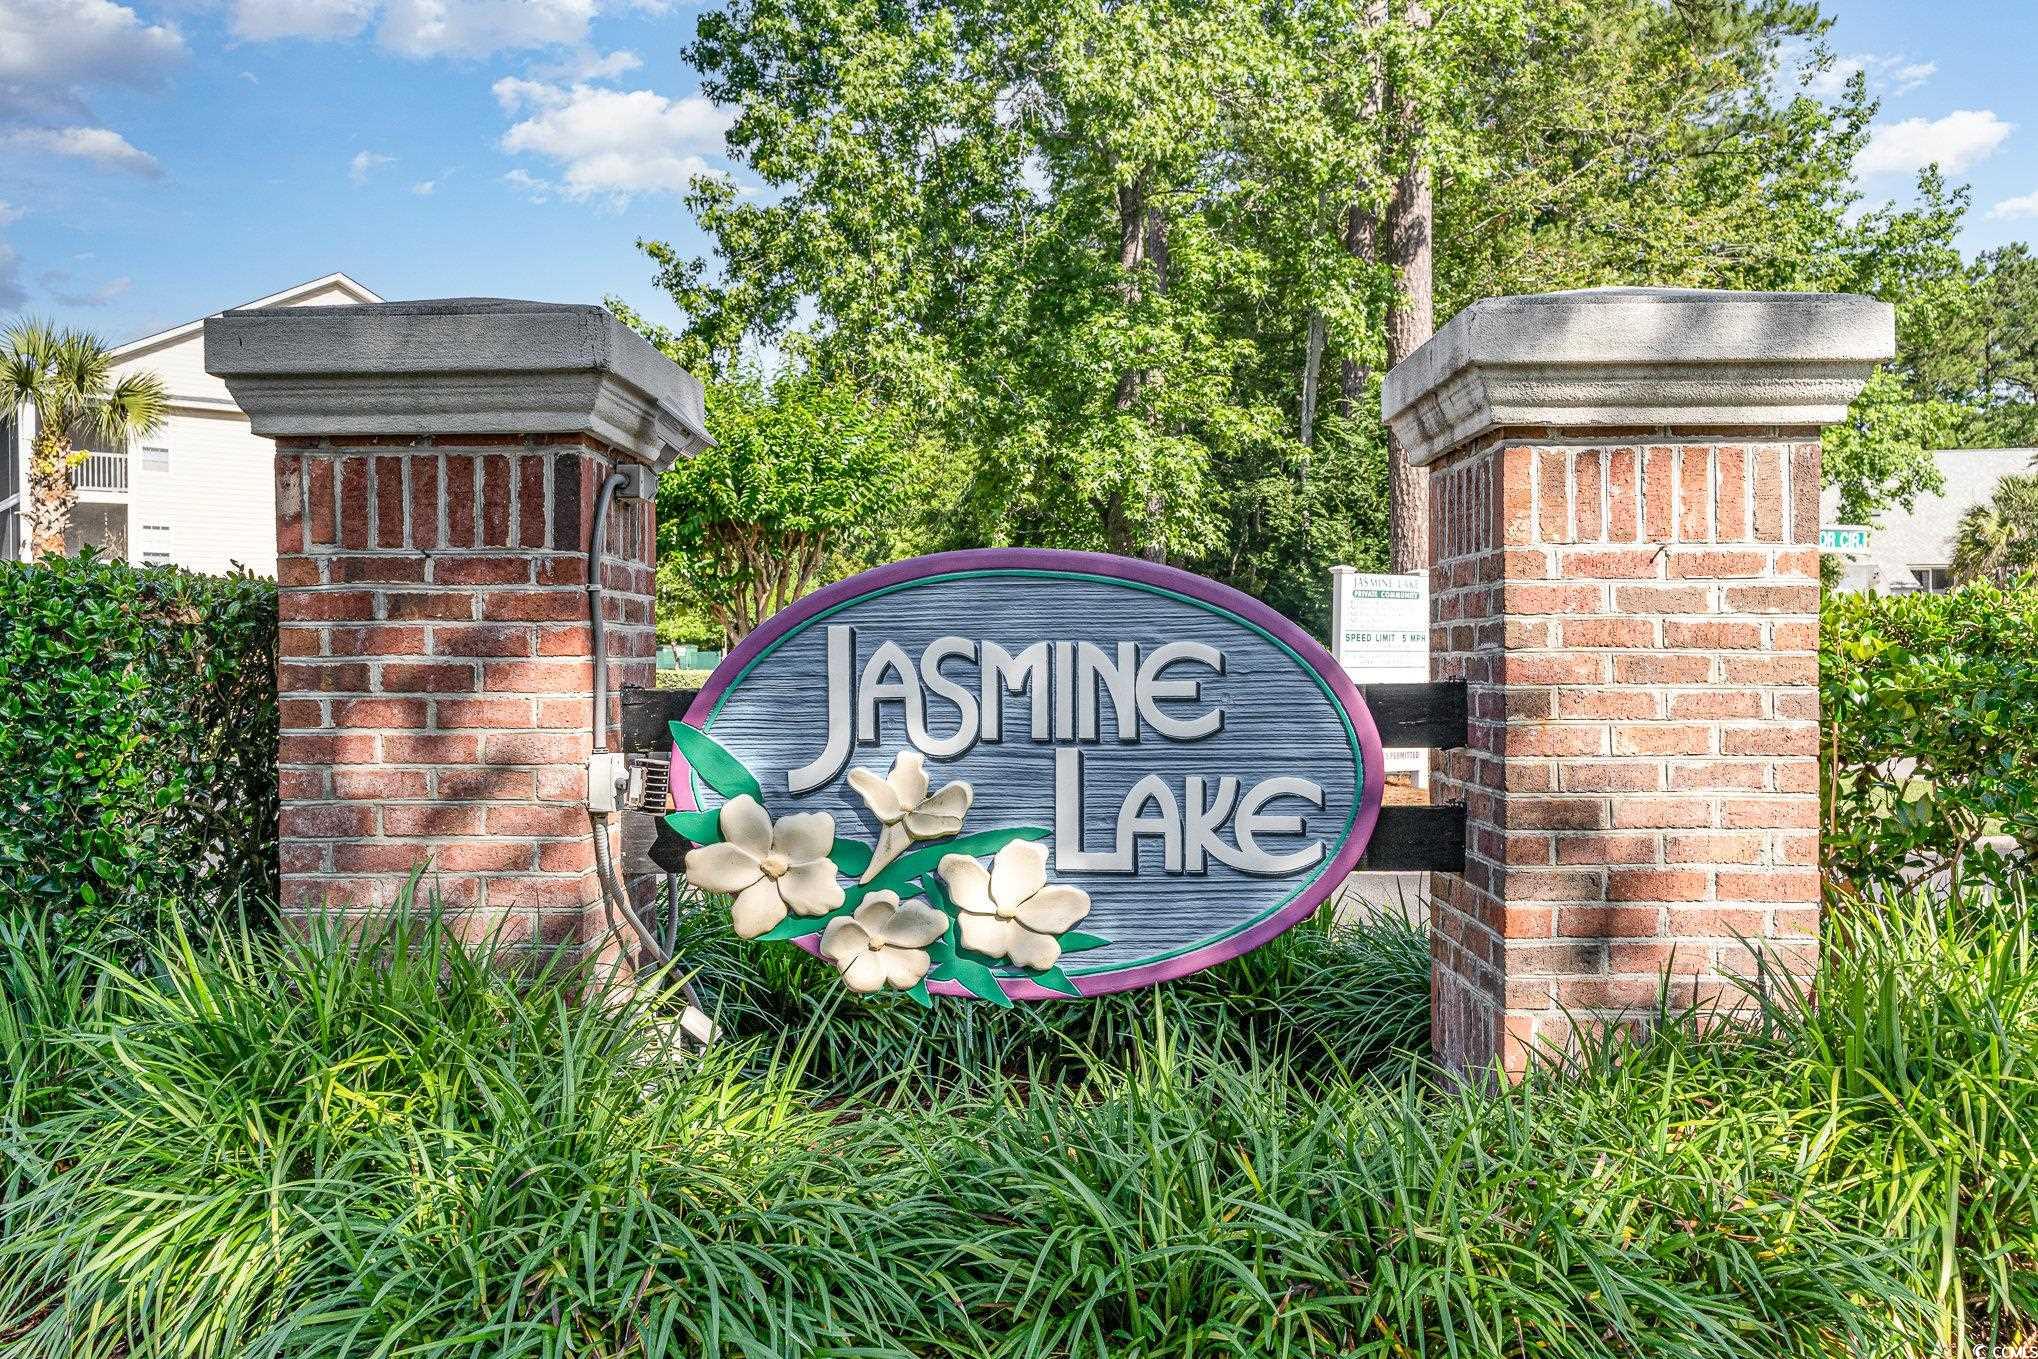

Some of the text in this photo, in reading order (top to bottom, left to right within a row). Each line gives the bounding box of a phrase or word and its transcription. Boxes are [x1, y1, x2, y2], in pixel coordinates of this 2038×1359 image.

[1354, 577, 1419, 589] JASMINE LAKE
[1354, 590, 1419, 599] PRIVATE COMMUNITY
[1345, 633, 1426, 642] SPEED LIMIT 5 MPH
[787, 625, 1226, 795] JASMINE
[1055, 747, 1327, 877] LAKE
